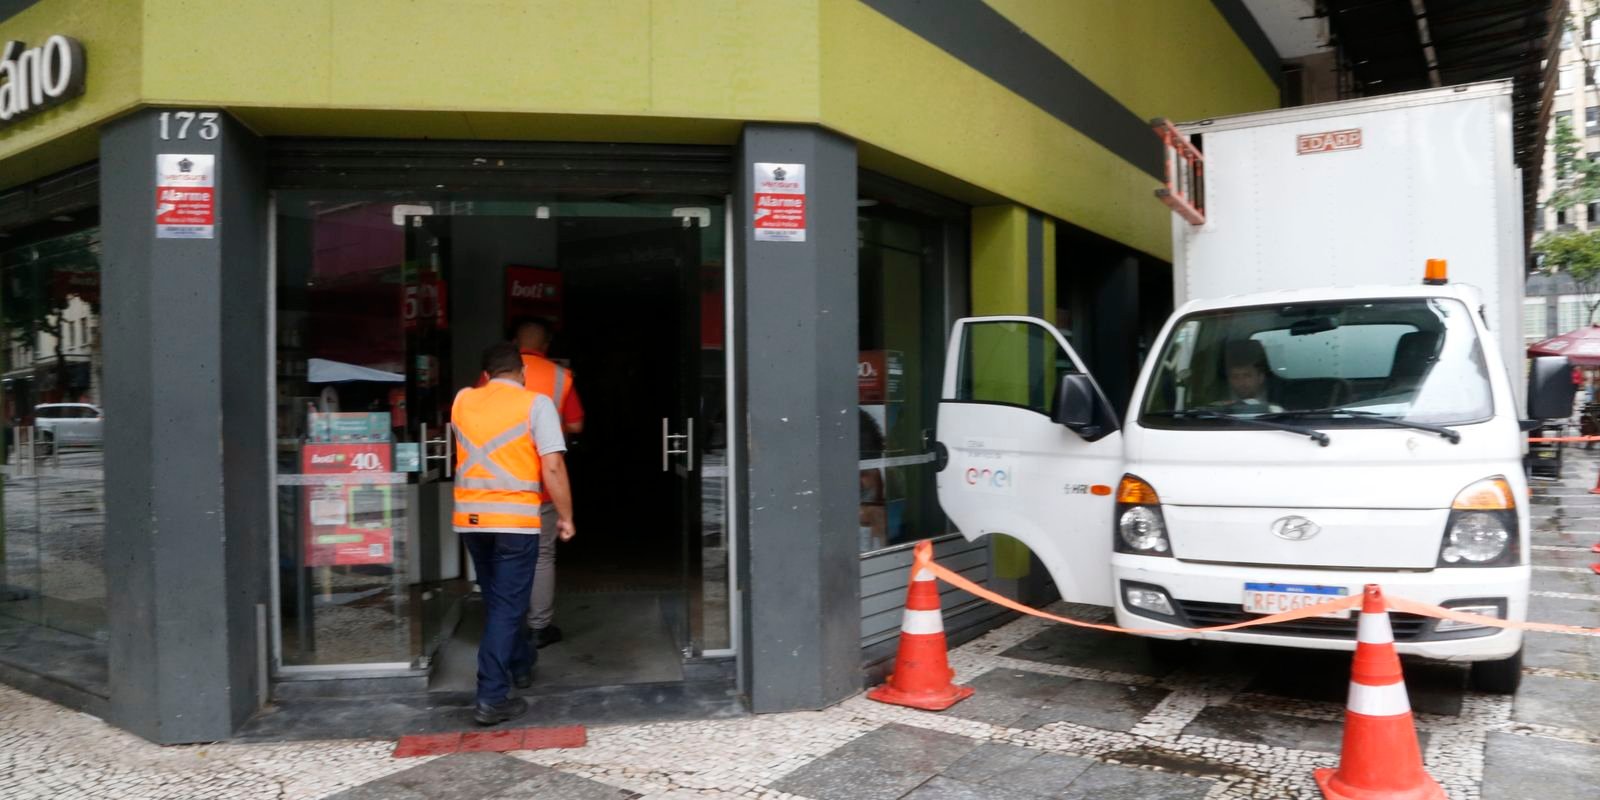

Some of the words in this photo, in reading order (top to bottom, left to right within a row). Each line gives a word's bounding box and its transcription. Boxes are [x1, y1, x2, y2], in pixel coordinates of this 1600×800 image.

[158, 111, 220, 140] 173
[160, 189, 211, 202] Alarme
[758, 195, 803, 208] Alarme
[965, 466, 1013, 488] enel
